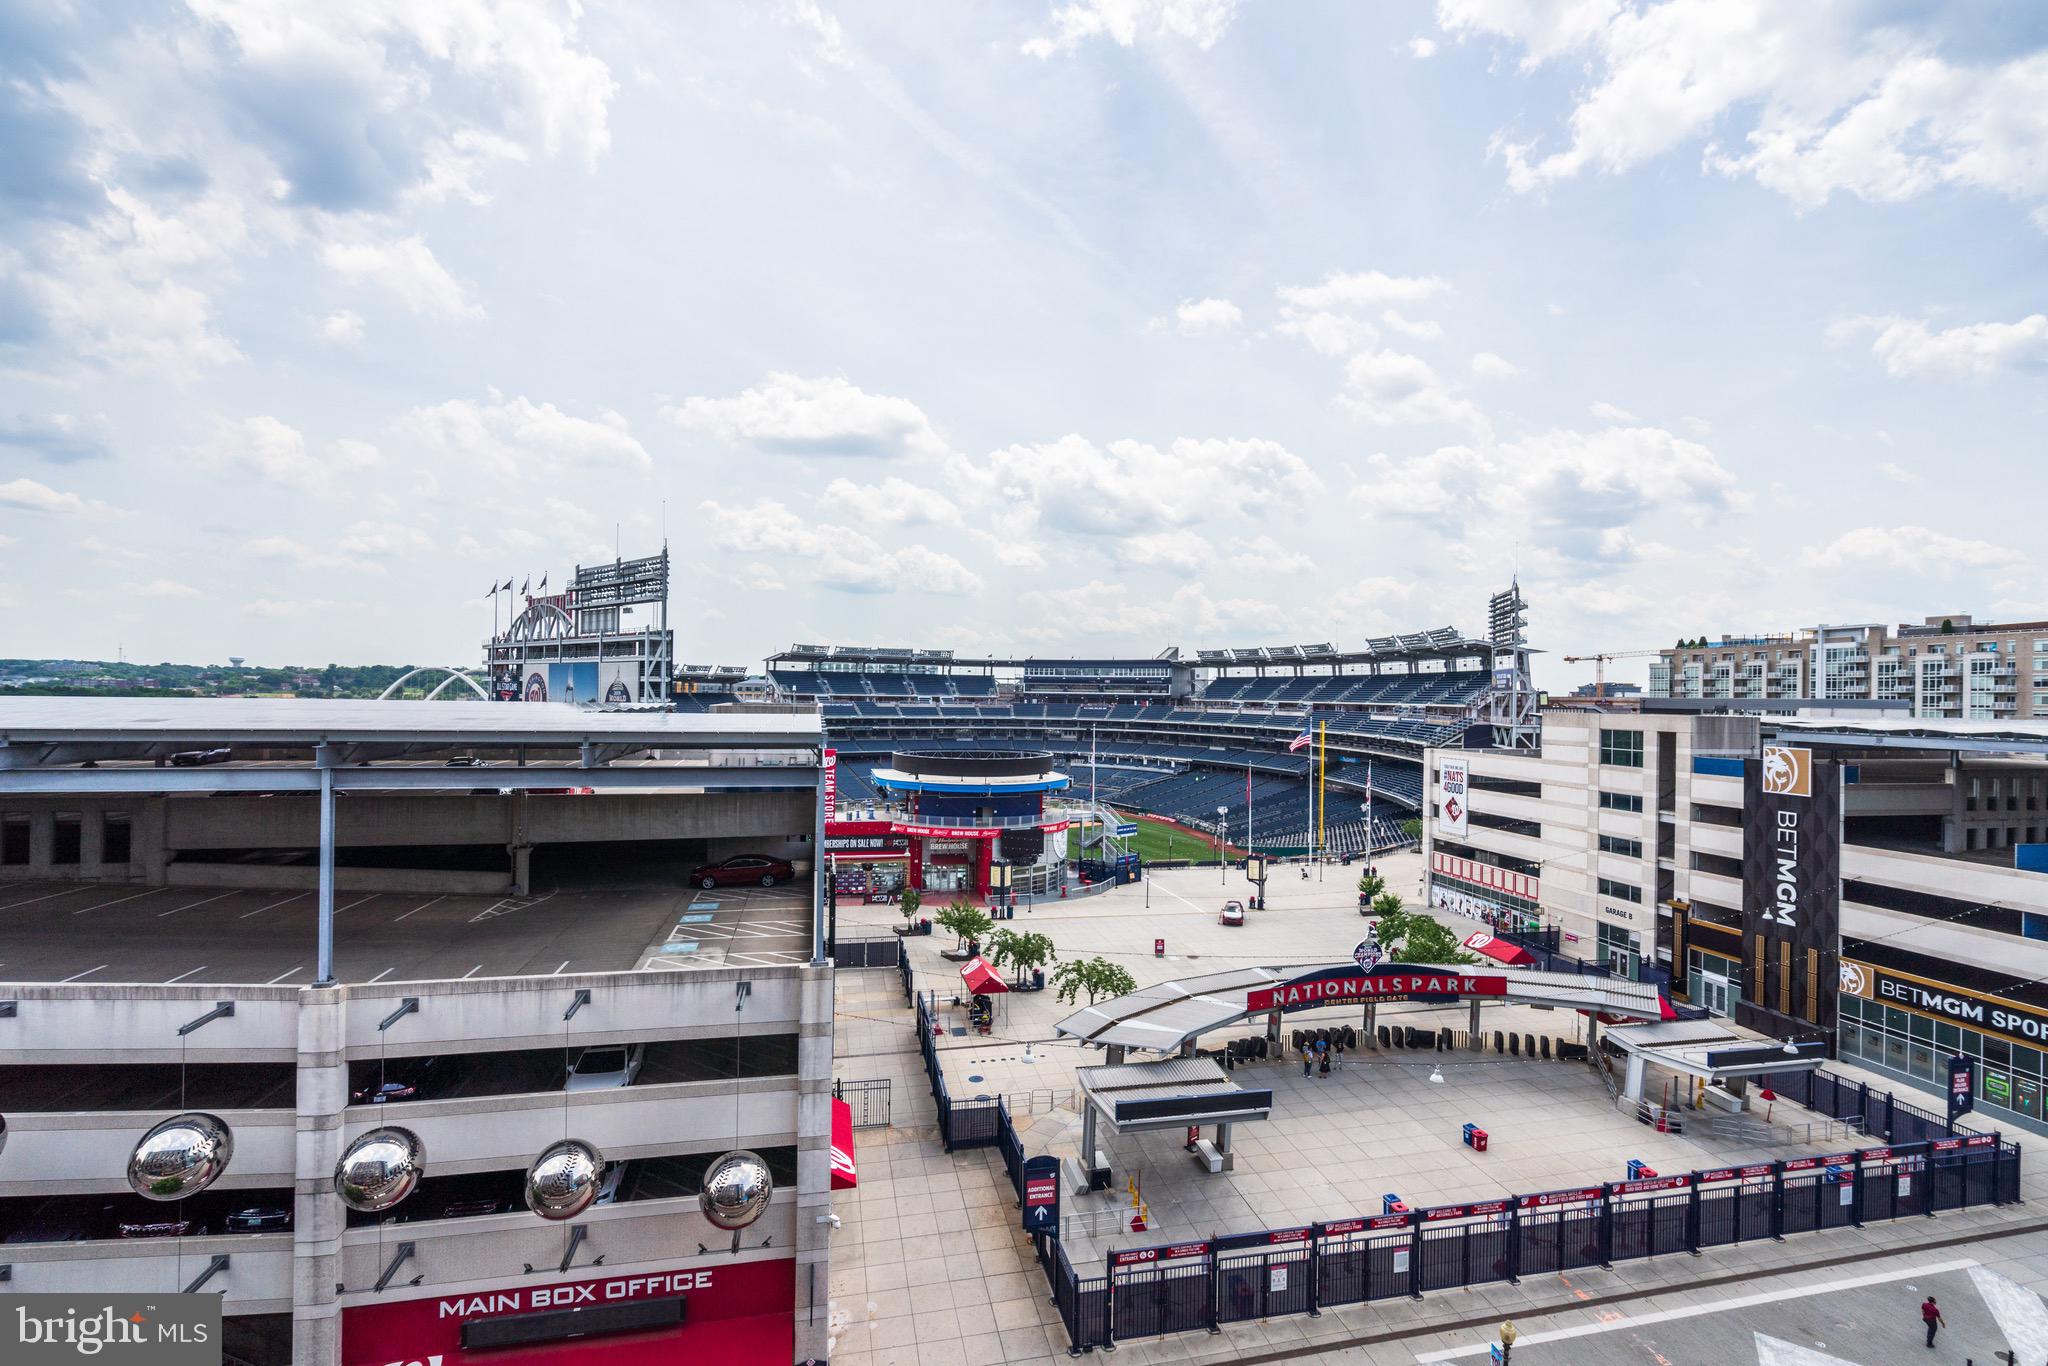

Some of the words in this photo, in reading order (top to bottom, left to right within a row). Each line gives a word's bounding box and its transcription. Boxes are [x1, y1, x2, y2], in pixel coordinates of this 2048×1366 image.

[825, 769, 835, 793] TEAM
[1444, 770, 1463, 782] #NATS
[1444, 781, 1464, 794] 4GOOD
[824, 794, 835, 824] STORE
[850, 839, 857, 848] ON
[858, 839, 870, 848] SALE
[870, 839, 883, 847] NOW!
[1776, 810, 1797, 927] BETMGM
[1605, 906, 1627, 918] GARAGE
[1273, 978, 1403, 1004] NATIONALS
[1412, 977, 1477, 992] PARK
[1324, 997, 1358, 1005] CENTER
[1360, 995, 1385, 1003] FIELD
[1881, 979, 1984, 1022] BETMGM
[1027, 1185, 1055, 1193] ADDITIONAL
[439, 1293, 520, 1318] MAIN
[531, 1283, 596, 1308] BOX
[605, 1271, 712, 1299] OFFICE
